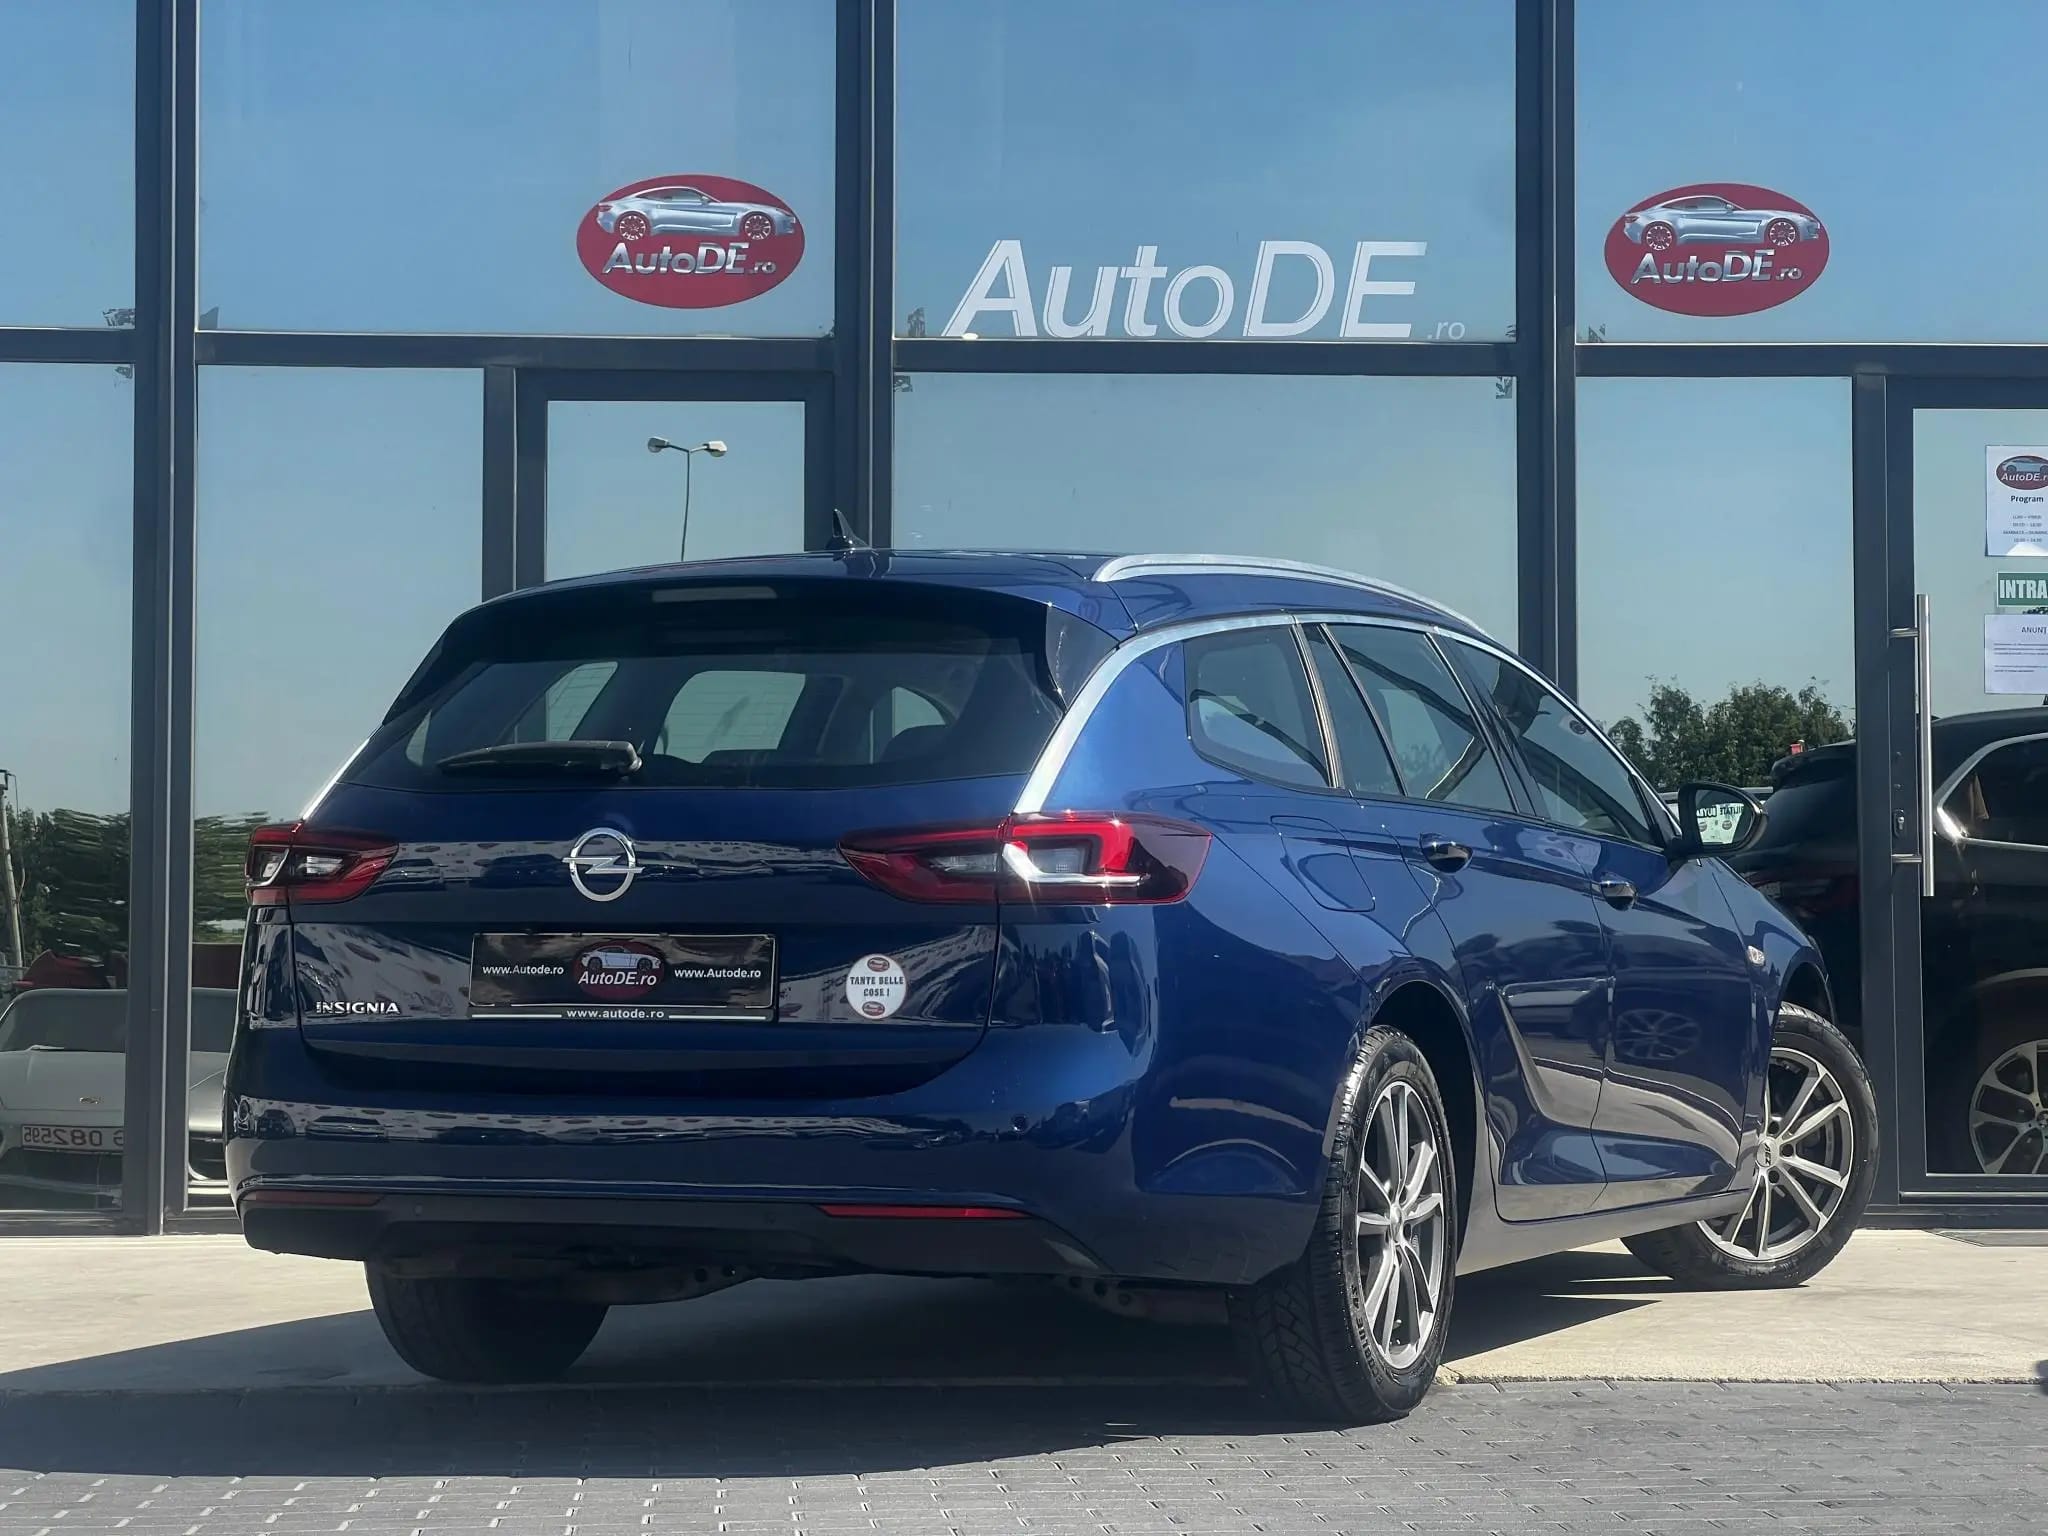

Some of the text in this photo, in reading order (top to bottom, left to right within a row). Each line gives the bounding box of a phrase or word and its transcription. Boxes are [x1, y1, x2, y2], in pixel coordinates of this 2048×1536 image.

[2010, 495, 2044, 503] Program
[482, 964, 564, 975] www.Autode.ro
[674, 967, 762, 978] www.Autode.ro
[578, 970, 657, 986] AutoDE.ro
[849, 976, 904, 985] TANTE BELLE
[863, 988, 885, 997] COSE
[316, 1001, 401, 1014] INSIGNIA
[566, 1009, 665, 1019] www.autode.ro
